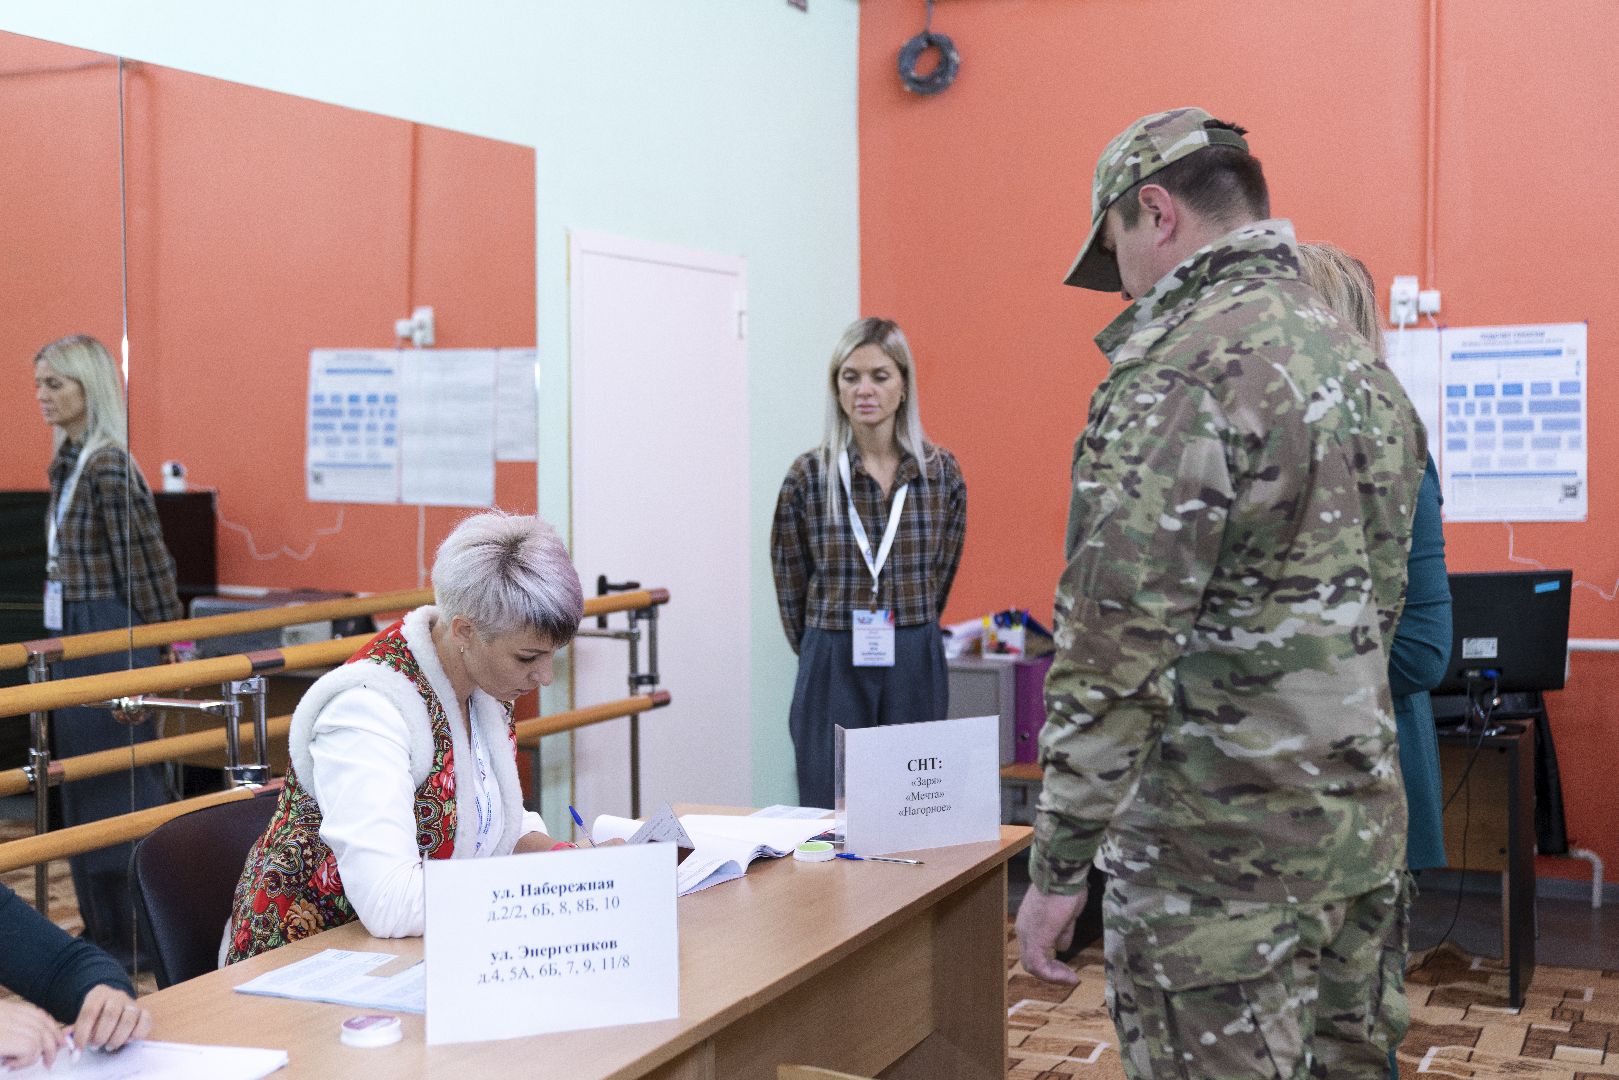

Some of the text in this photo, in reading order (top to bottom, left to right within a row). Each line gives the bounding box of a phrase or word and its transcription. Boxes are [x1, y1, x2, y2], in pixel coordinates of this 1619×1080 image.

[907, 757, 942, 772] СНТ:
[911, 776, 943, 788] «Заря»
[905, 791, 945, 801] «Мечта»
[898, 804, 952, 817] «Нагорное»
[492, 879, 615, 903] ул. Набережная
[531, 902, 555, 917] 6Б,
[559, 900, 572, 915] 8,
[576, 898, 599, 913] 8Б,
[604, 895, 620, 910] 10
[490, 939, 619, 965] ул. Энергетиков
[539, 962, 562, 977] 6Б,
[566, 960, 580, 975] 7,
[583, 958, 596, 973] 9,
[602, 954, 631, 971] 11/8
